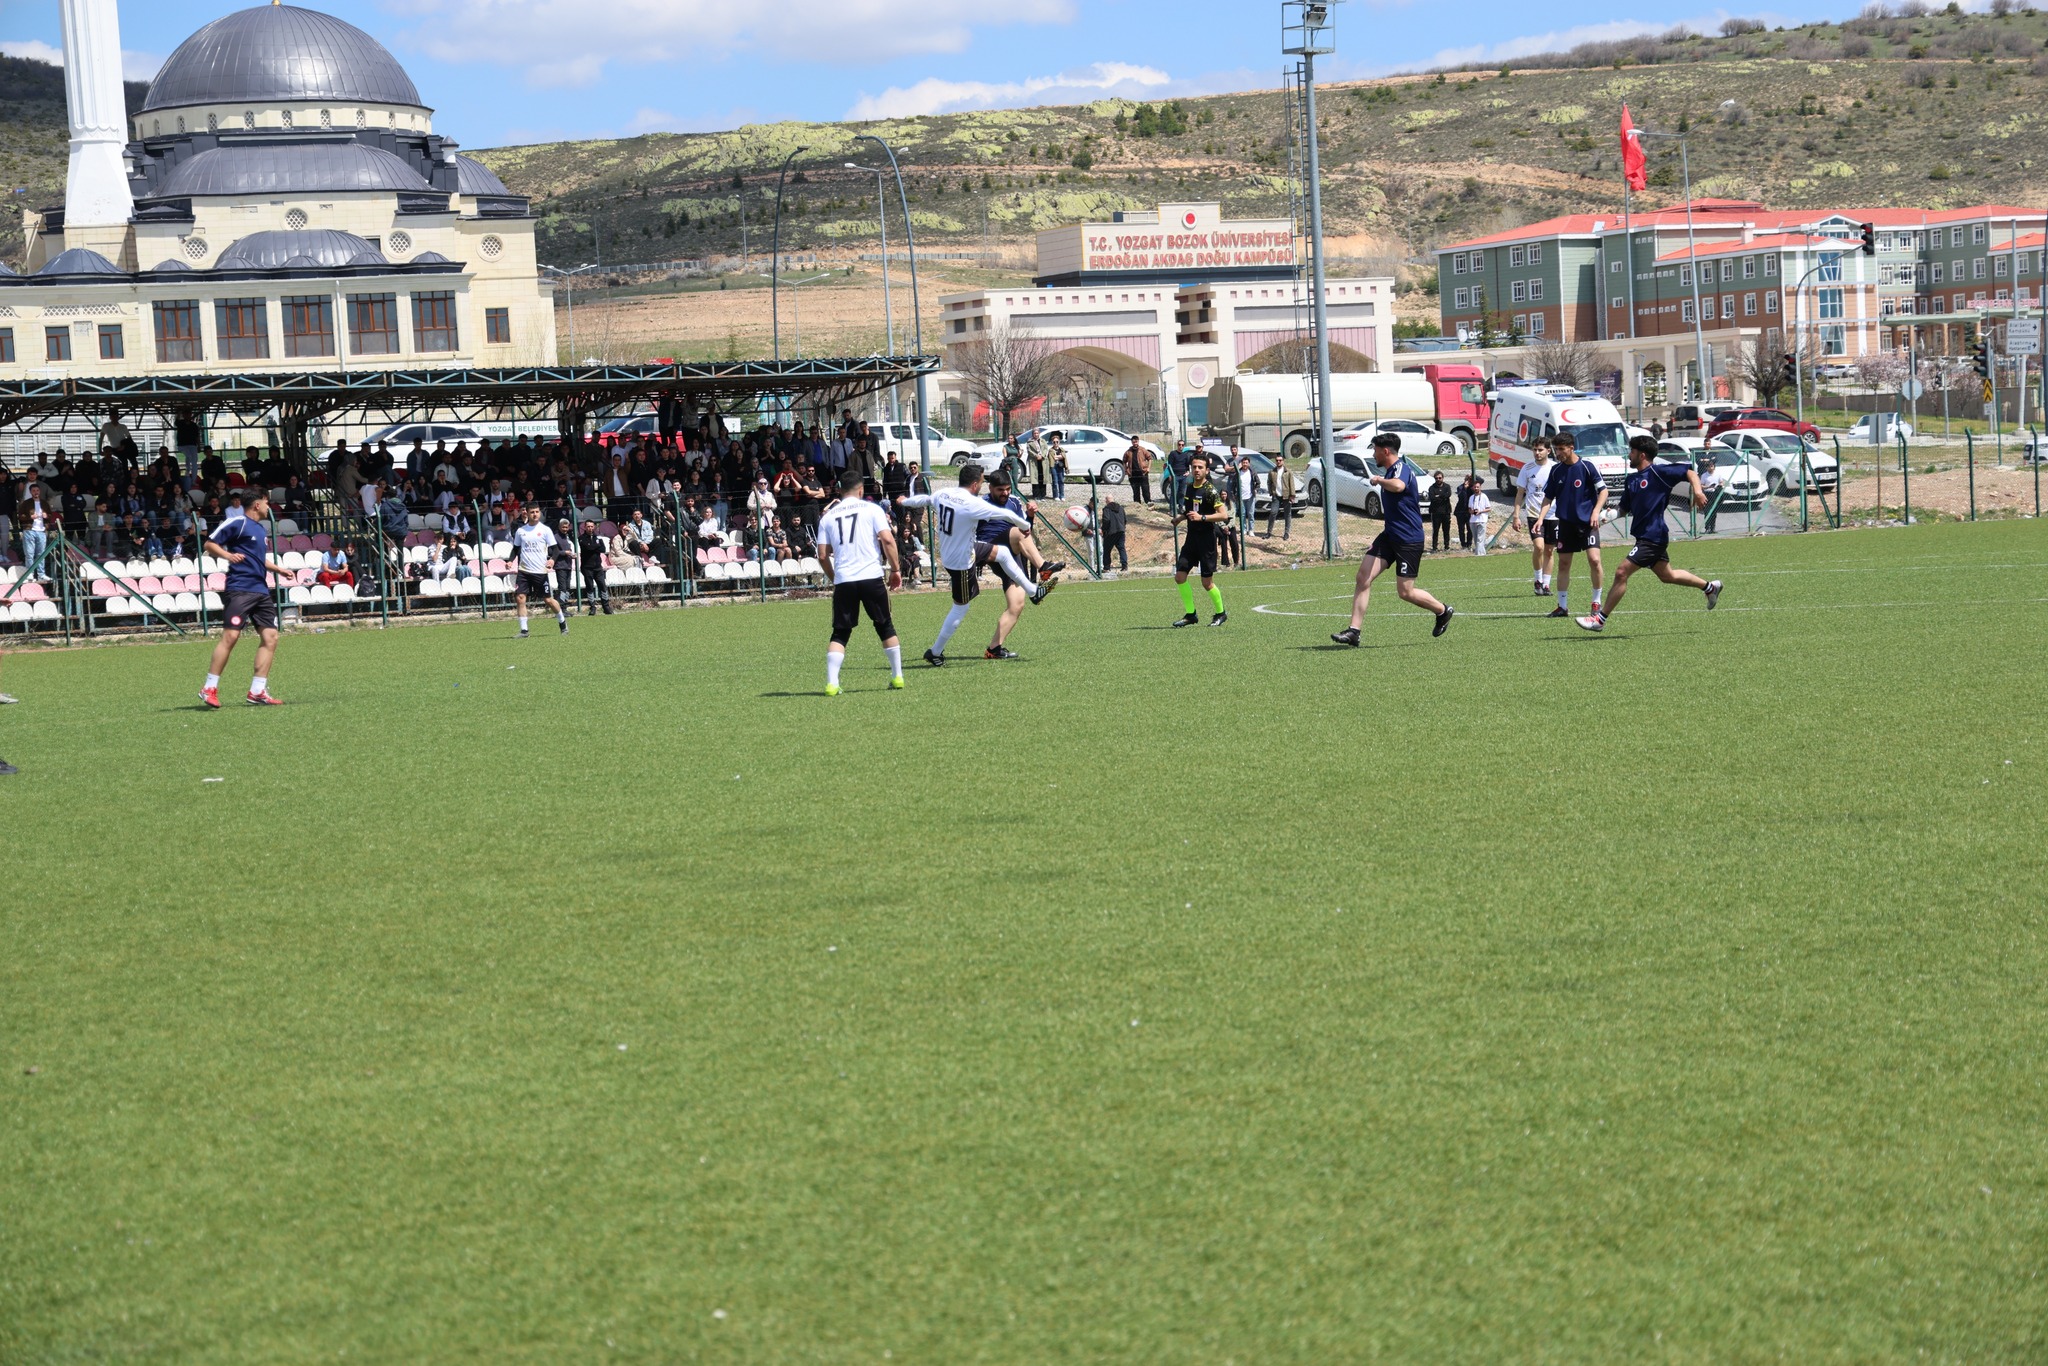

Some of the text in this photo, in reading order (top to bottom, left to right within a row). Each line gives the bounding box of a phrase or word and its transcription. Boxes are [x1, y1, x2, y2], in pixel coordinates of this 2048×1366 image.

[1089, 229, 1293, 251] T.C. YOZGAT BOZOK ÜNİVERSİTESİ
[1090, 251, 1149, 270] ERDOĞAN
[1197, 249, 1231, 265] DOĞU
[1234, 247, 1292, 265] KAMPÜSÜ
[518, 425, 557, 433] BELEDİYES
[939, 503, 955, 537] 10
[835, 513, 858, 545] 17
[1587, 535, 1596, 546] 10
[1628, 546, 1639, 557] 8
[1400, 562, 1408, 574] 2
